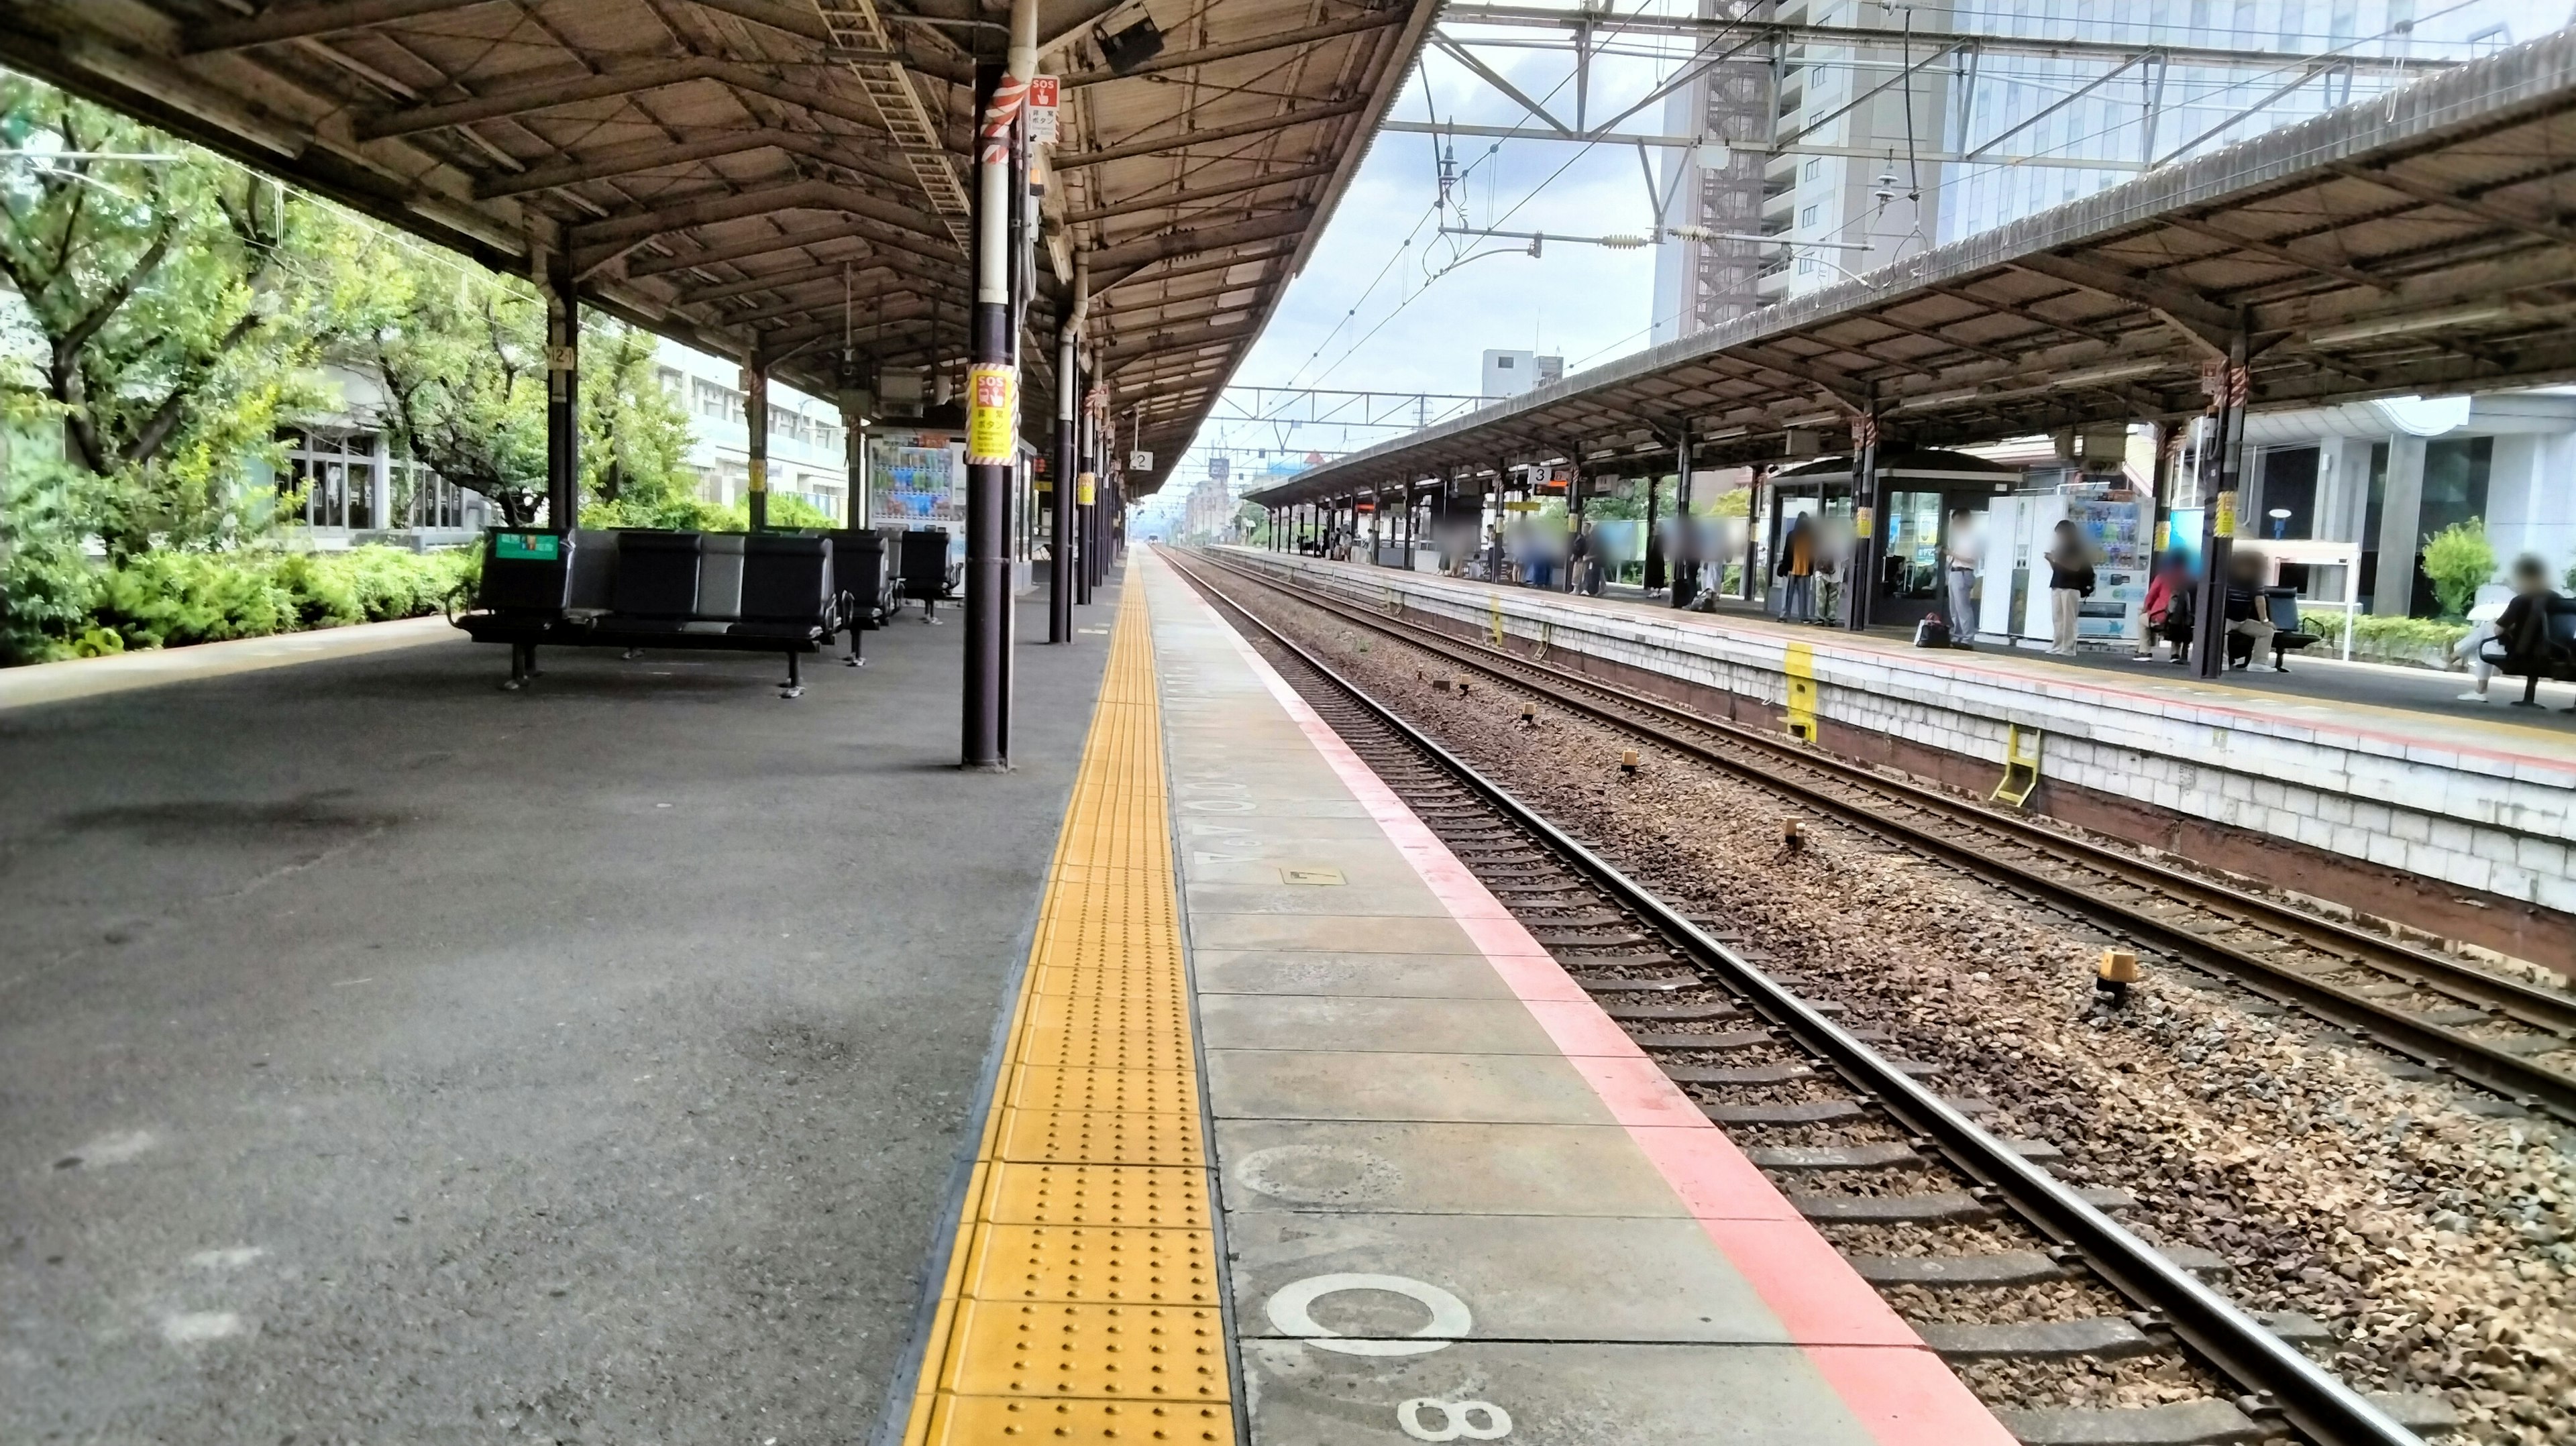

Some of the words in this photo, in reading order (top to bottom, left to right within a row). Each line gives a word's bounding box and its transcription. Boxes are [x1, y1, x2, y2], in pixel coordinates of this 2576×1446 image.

[1032, 79, 1054, 89] SOS
[978, 376, 1004, 387] SOS
[977, 421, 1004, 429] ボタン
[1137, 454, 1146, 467] 2
[1536, 469, 1545, 482] 3
[1397, 1398, 1513, 1442] 8
